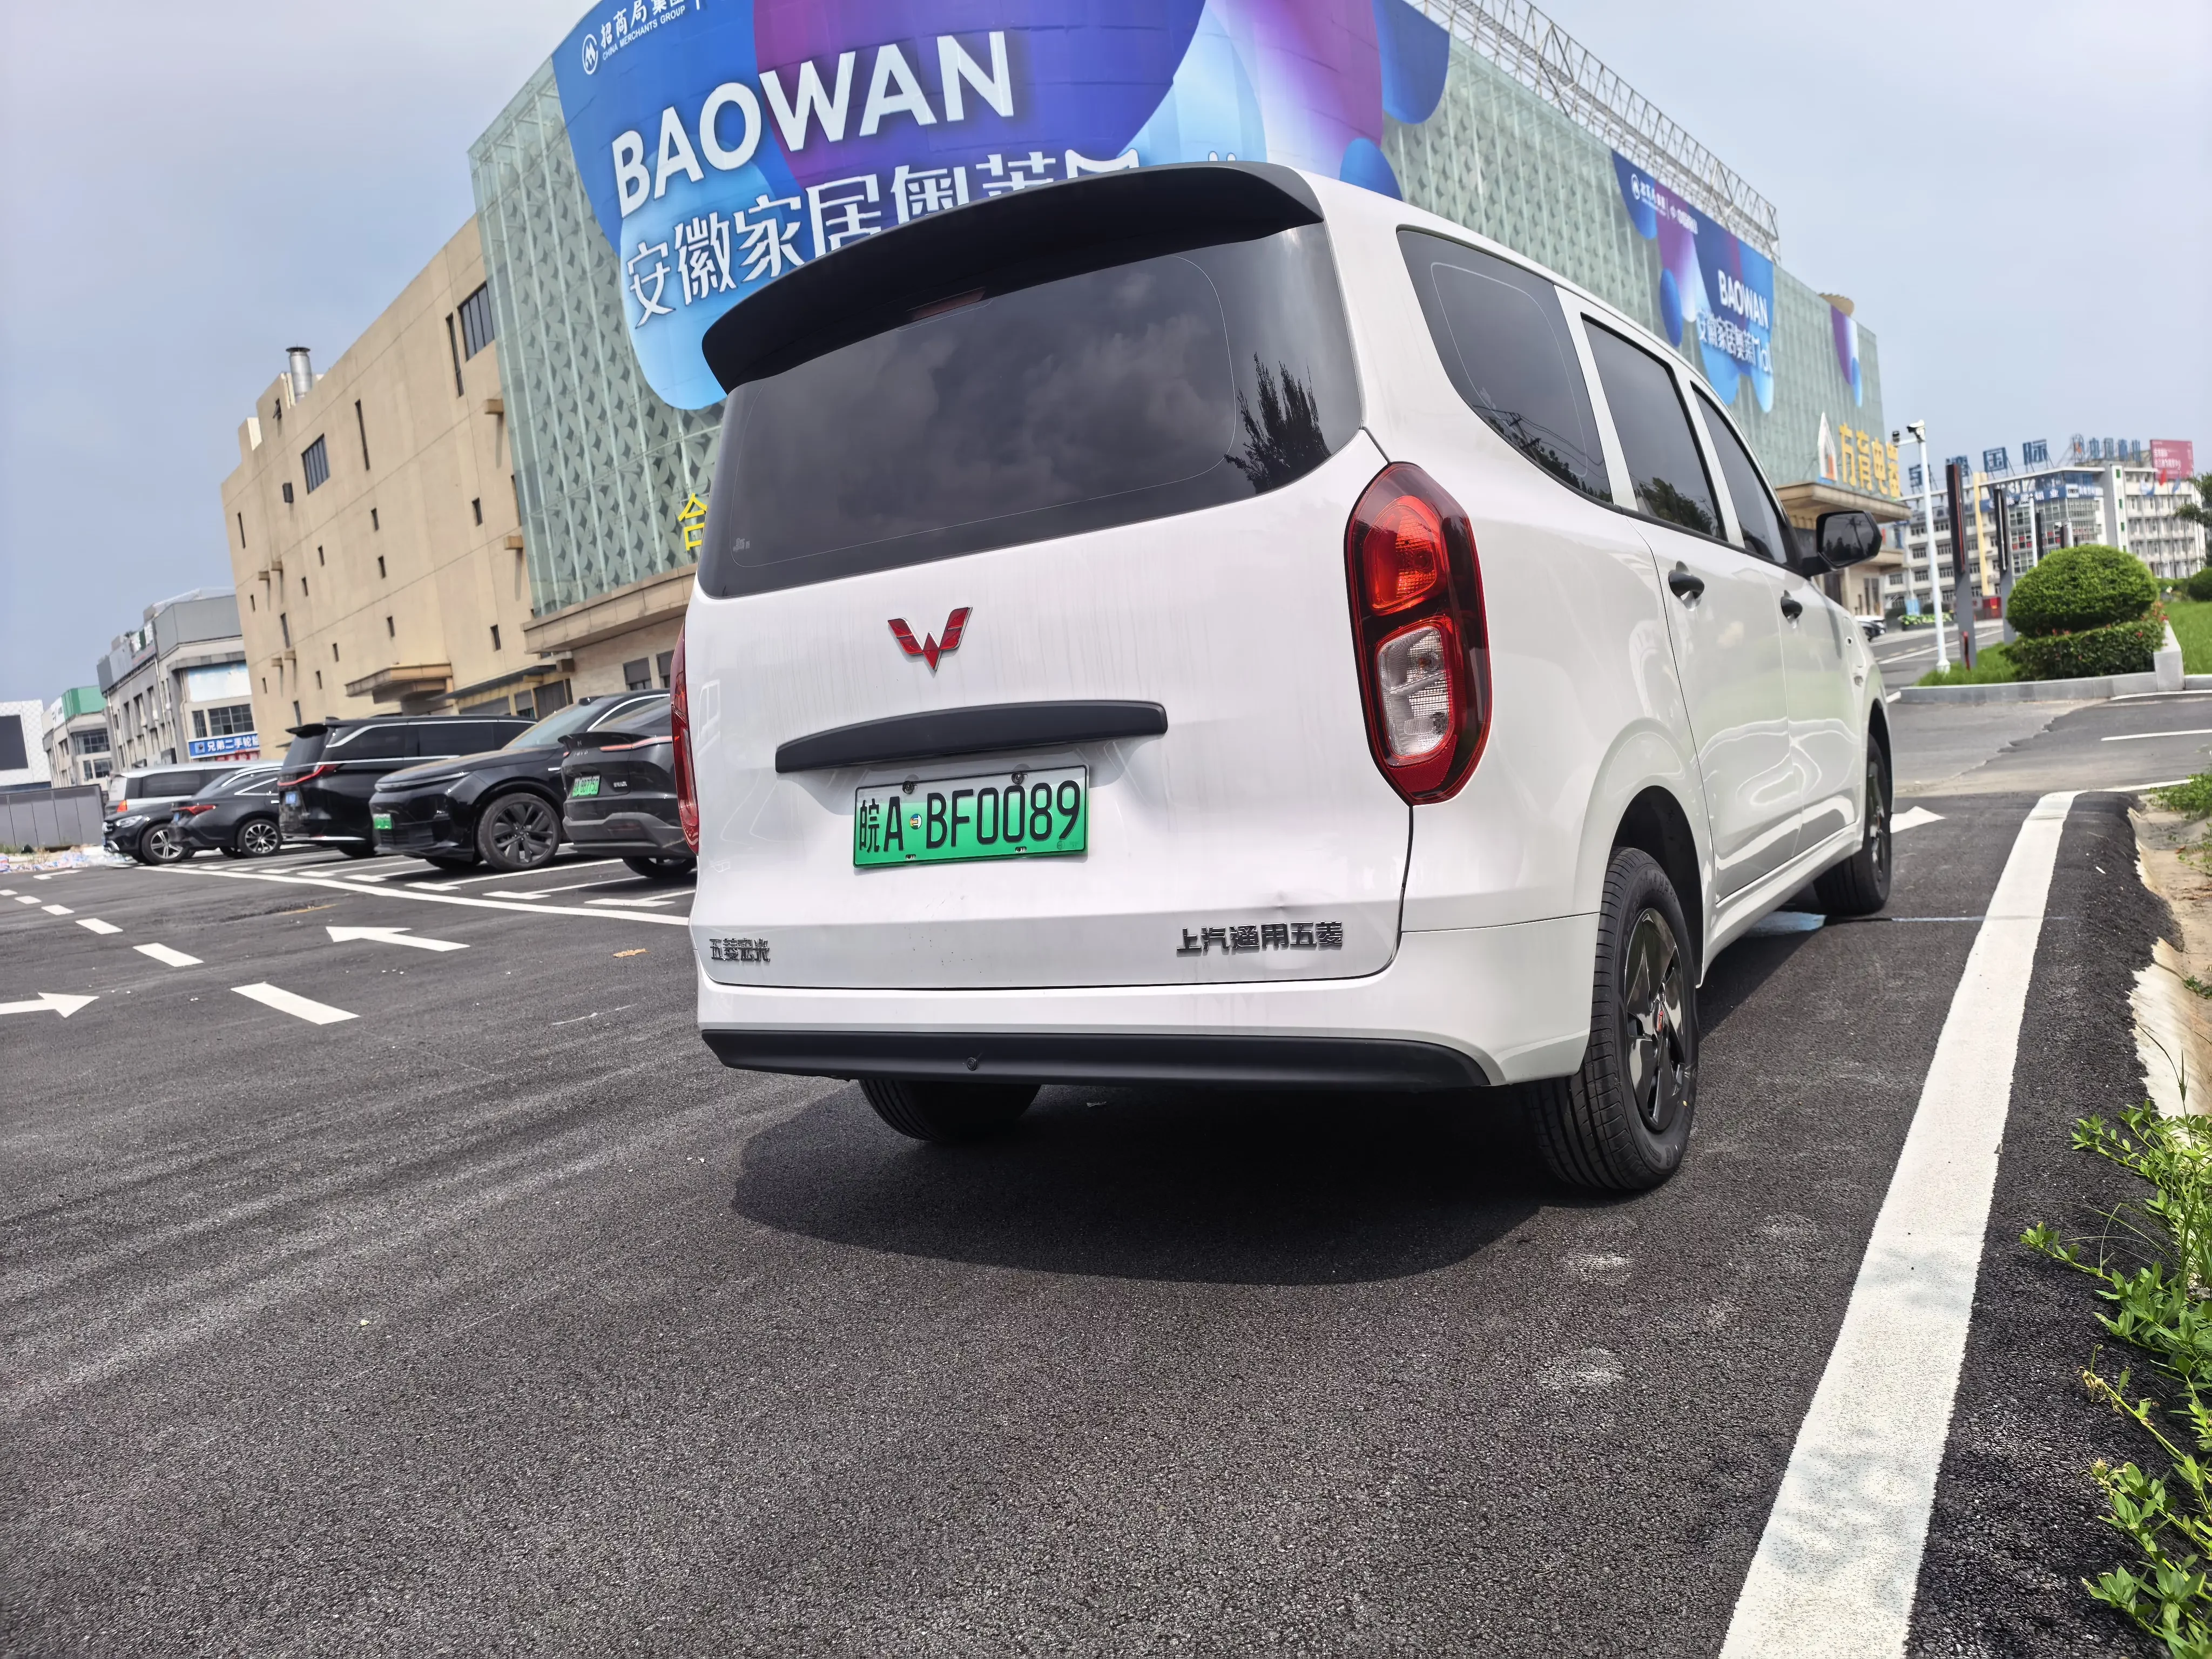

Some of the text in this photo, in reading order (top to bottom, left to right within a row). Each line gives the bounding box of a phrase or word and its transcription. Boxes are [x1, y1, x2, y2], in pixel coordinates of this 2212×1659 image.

[601, 0, 684, 49] 招商局集
[603, 5, 685, 60] CHINA MERCHANTS GROUP
[612, 31, 1014, 219] BAOWAN
[1718, 268, 1769, 330] BAOWAN
[709, 938, 771, 961] 五菱宏光
[1176, 920, 1344, 952] 上汽通用五菱
